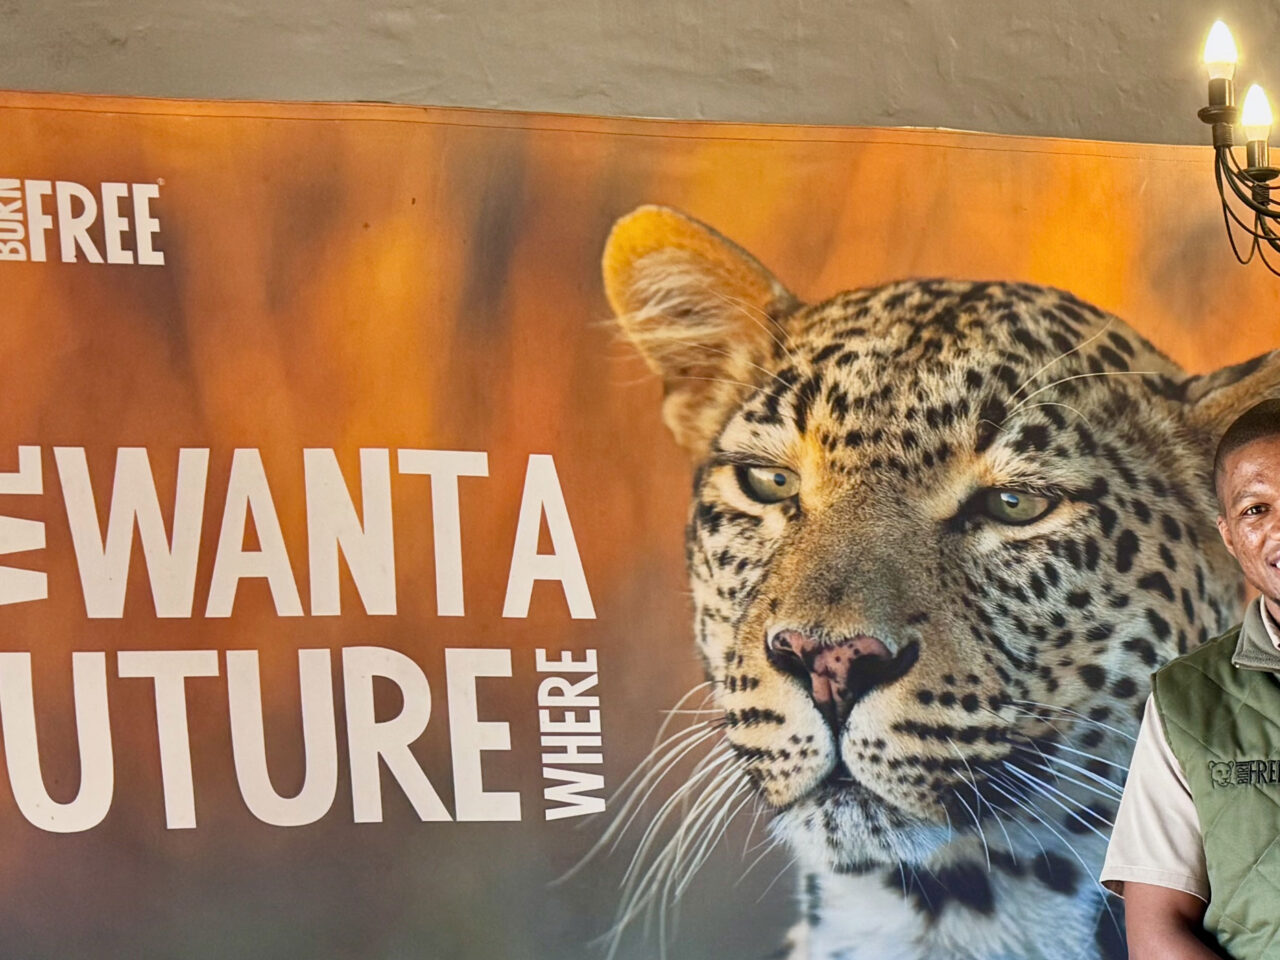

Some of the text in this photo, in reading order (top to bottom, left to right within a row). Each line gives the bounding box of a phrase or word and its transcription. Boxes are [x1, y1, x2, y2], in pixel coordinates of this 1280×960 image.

[24, 179, 165, 265] FREE
[53, 446, 489, 618] WANT
[502, 454, 597, 619] A
[0, 646, 521, 832] UTURE
[535, 648, 606, 821] WHERE
